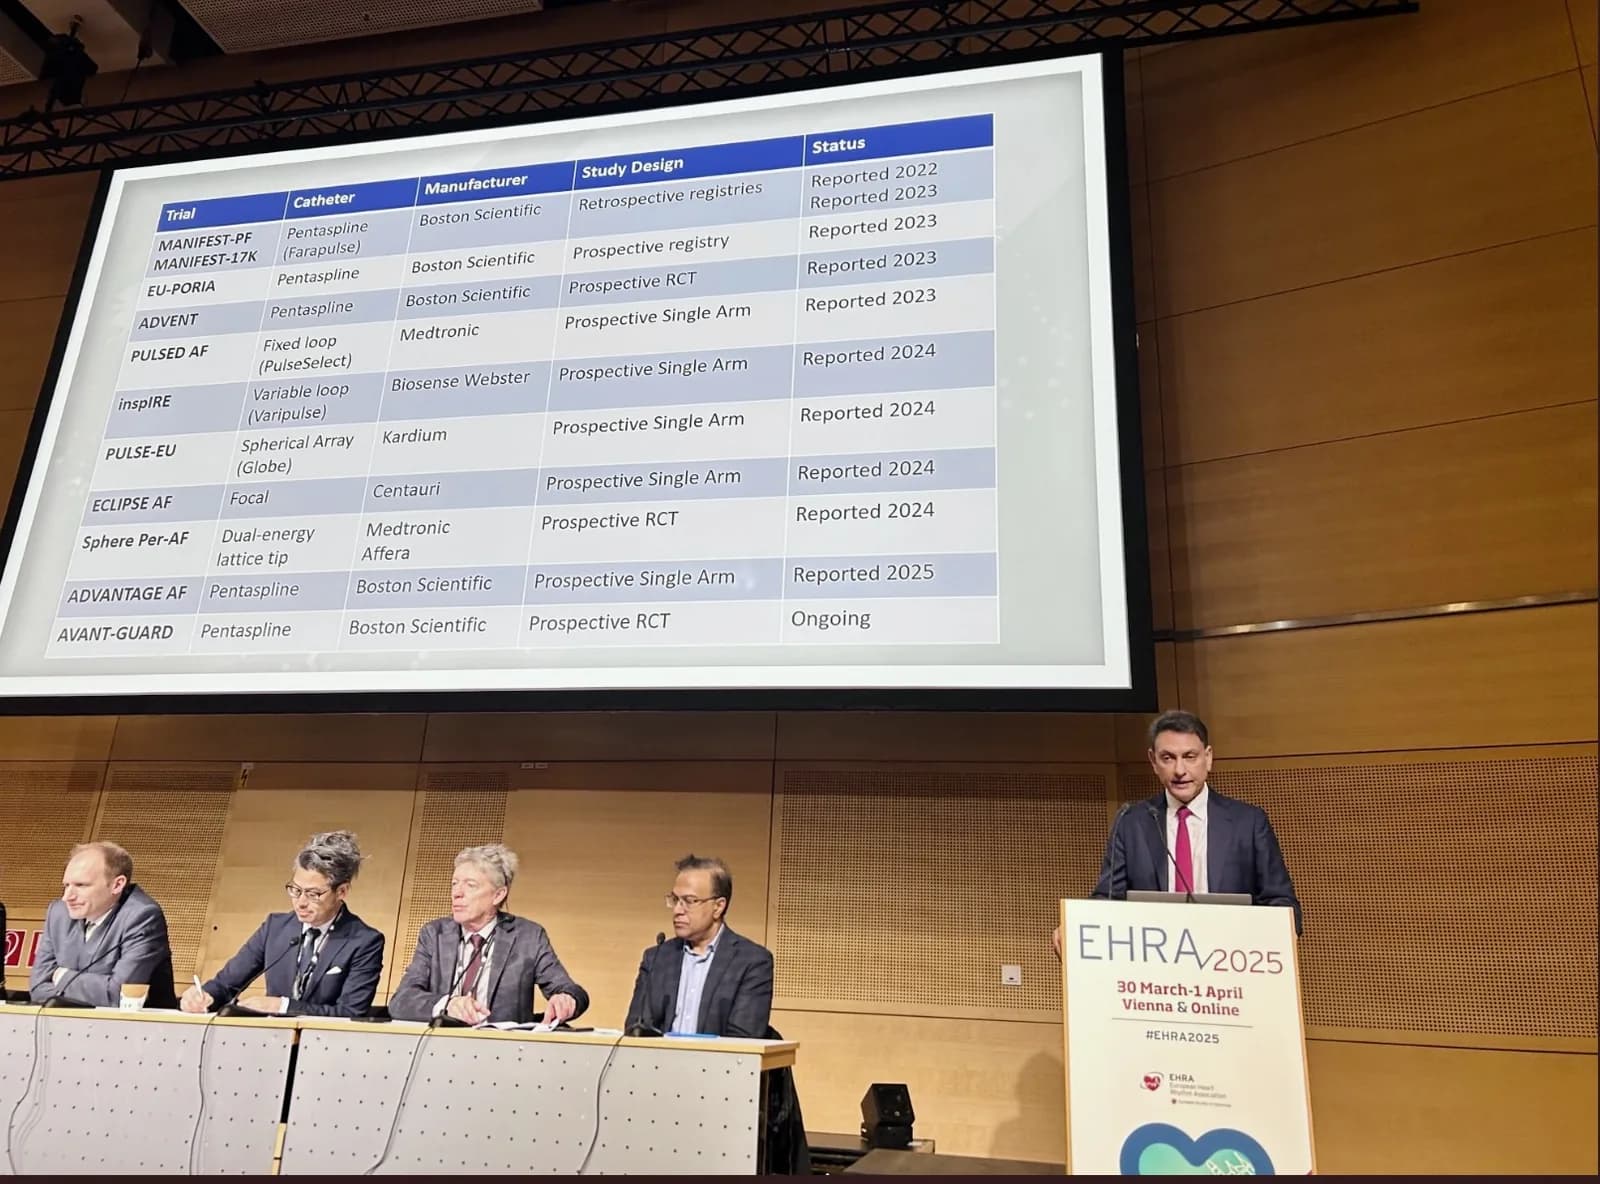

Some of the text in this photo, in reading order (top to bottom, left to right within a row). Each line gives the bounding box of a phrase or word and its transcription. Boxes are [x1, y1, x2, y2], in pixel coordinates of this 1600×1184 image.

[813, 139, 865, 153] Status
[582, 159, 683, 178] Study Design
[812, 163, 937, 188] Reported 2022
[425, 176, 528, 194] Manufacturer
[294, 194, 355, 208] Catheter
[580, 184, 762, 211] Retrospective registries
[811, 185, 937, 210] Reported 2023
[168, 208, 195, 220] Trial
[420, 204, 541, 226] Boston Scientific
[288, 223, 368, 242] Pentaspline
[810, 214, 936, 239] Reported 2023
[159, 232, 253, 252] MANIFEST-PF
[284, 240, 360, 261] (Farapulse)
[574, 236, 729, 259] Prospective registry
[154, 251, 257, 270] MANIFEST-17K
[412, 252, 535, 273] Boston Scientific
[808, 251, 936, 275] Reported 2023
[278, 269, 359, 286] Pentaspline
[570, 272, 697, 294] Prospective RCT
[148, 281, 215, 296] EU-PORIA
[406, 286, 530, 307] Boston Scientific
[271, 301, 353, 318] Pentaspline
[806, 289, 936, 312] Reported 2023
[138, 313, 199, 329] ADVENT
[566, 305, 750, 330] Prospective Single Arm
[400, 324, 479, 341] Medtronic
[131, 345, 208, 362] PULSED AF
[264, 337, 336, 354] Fixed loop
[259, 353, 351, 376] (PulseSelect)
[804, 344, 936, 367] Reported 2024
[560, 358, 747, 381] Prospective Single Arm
[392, 372, 530, 391] Biosense Webster
[254, 384, 349, 400] Variable loop
[119, 395, 171, 411] inspIRE
[801, 401, 935, 424] Reported 2024
[249, 405, 326, 425] (Varipulse)
[554, 413, 744, 436] Prospective Single Arm
[241, 435, 354, 454] Spherical Array
[383, 429, 446, 444] Kardium
[106, 444, 176, 460] PULSE-EU
[237, 458, 291, 477] (Globe)
[799, 460, 934, 482] Reported 2024
[374, 482, 440, 497] Centauri
[547, 470, 740, 492] Prospective Single Arm
[92, 496, 172, 512] ECLIPSE AF
[231, 490, 269, 505] Focal
[542, 511, 679, 532] Prospective RCT
[797, 502, 934, 524] Reported 2024
[222, 528, 315, 543] Dual-energy
[367, 520, 450, 536] Medtronic
[82, 532, 189, 552] Sphere Per-AF
[217, 552, 288, 567] lattice tip
[362, 546, 409, 560] Affera
[357, 575, 492, 593] Boston Scientific
[535, 570, 734, 591] Prospective Single Arm
[795, 564, 933, 585] Reported 2025
[68, 586, 187, 603] ADVANTAGE AF
[210, 582, 299, 600] Pentaspline
[350, 617, 486, 635] Boston Scientific
[530, 613, 671, 633] Prospective RCT
[792, 610, 870, 630] Ongoing
[57, 626, 173, 641] AVANT-GUARD
[201, 622, 291, 640] Pentaspline
[1118, 981, 1243, 1000] 30 March-1 April
[1122, 999, 1239, 1016] Vienna & Online
[1146, 1031, 1219, 1044] #EHRA2025
[1169, 1074, 1194, 1082] EHRA
